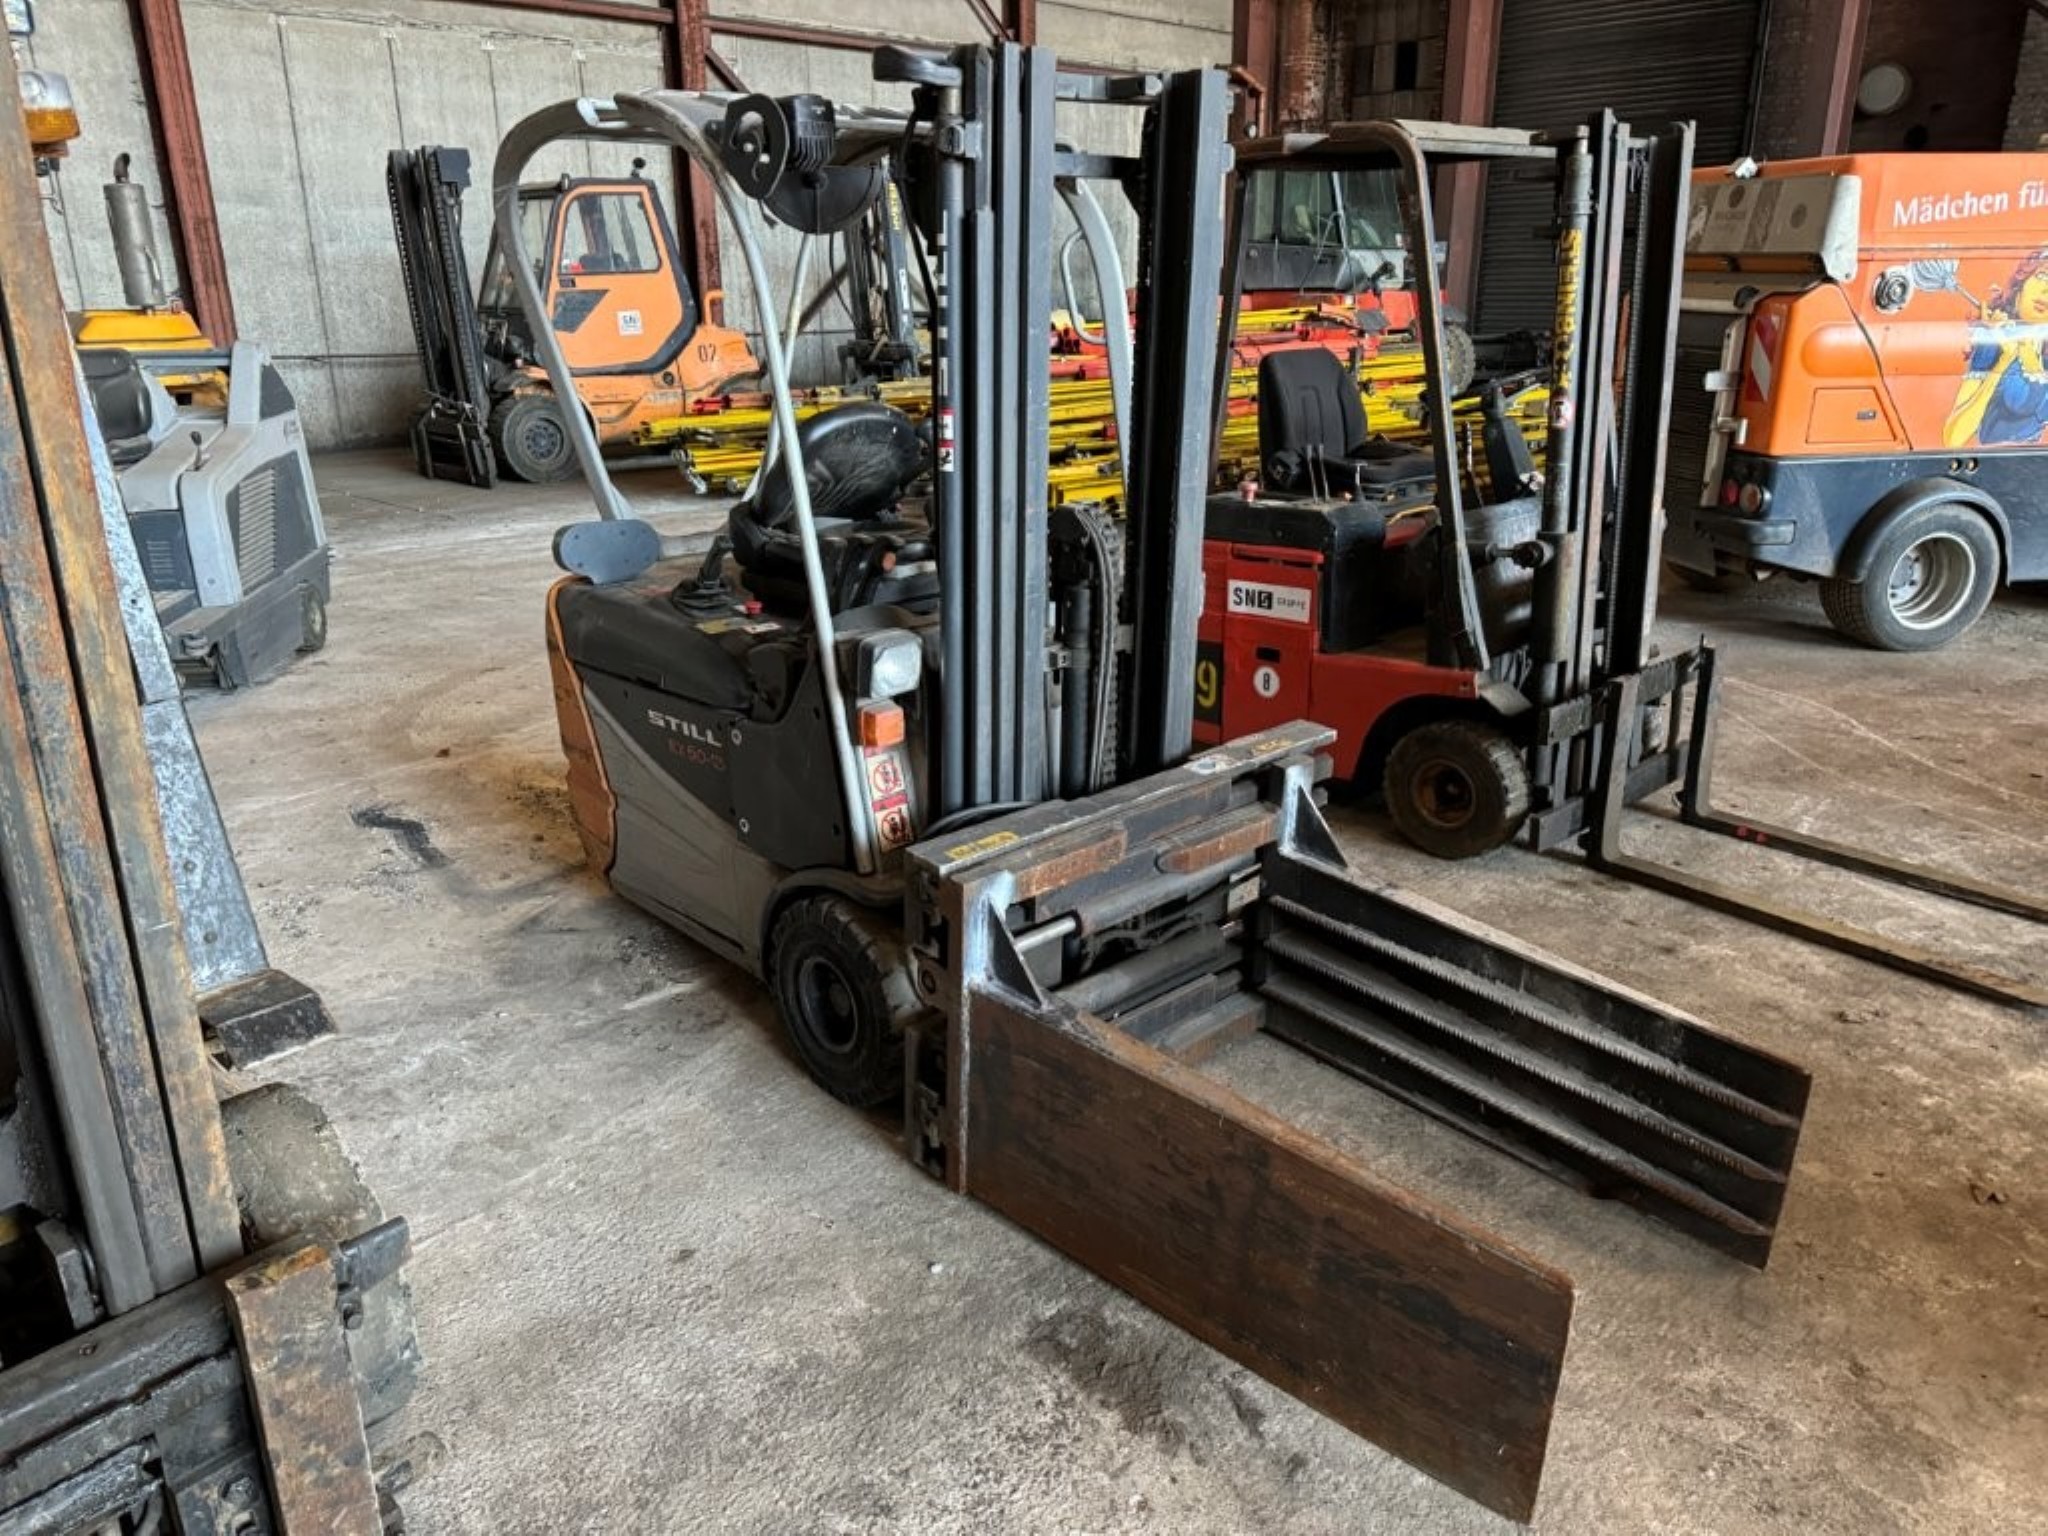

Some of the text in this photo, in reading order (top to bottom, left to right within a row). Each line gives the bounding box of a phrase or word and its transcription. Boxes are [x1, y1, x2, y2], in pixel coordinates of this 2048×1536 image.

[1893, 180, 2048, 227] Mädchen fü
[1197, 660, 1217, 707] 9
[648, 709, 722, 748] STILL
